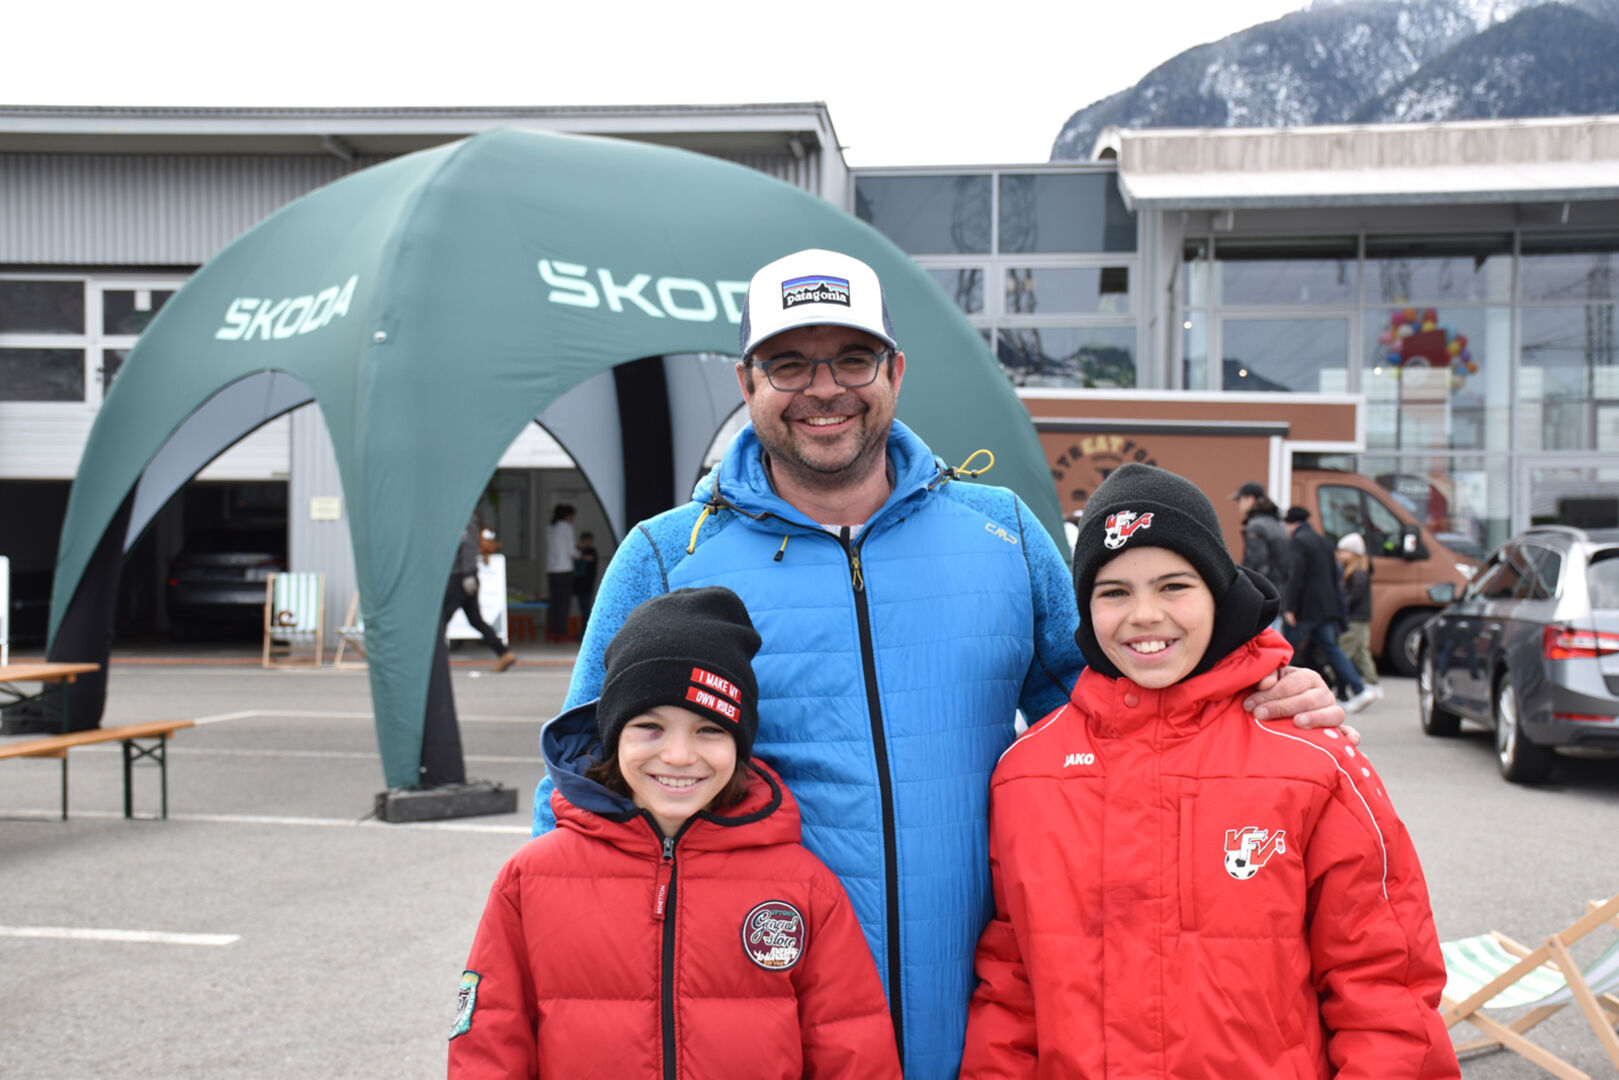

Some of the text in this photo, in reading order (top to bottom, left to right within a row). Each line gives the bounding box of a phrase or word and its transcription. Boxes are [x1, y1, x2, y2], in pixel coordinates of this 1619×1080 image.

[786, 290, 847, 306] patagonia
[699, 670, 739, 699] I MAKE MY
[696, 690, 736, 718] OWN RULES
[1063, 753, 1096, 768] JAKO
[750, 909, 799, 944] General
